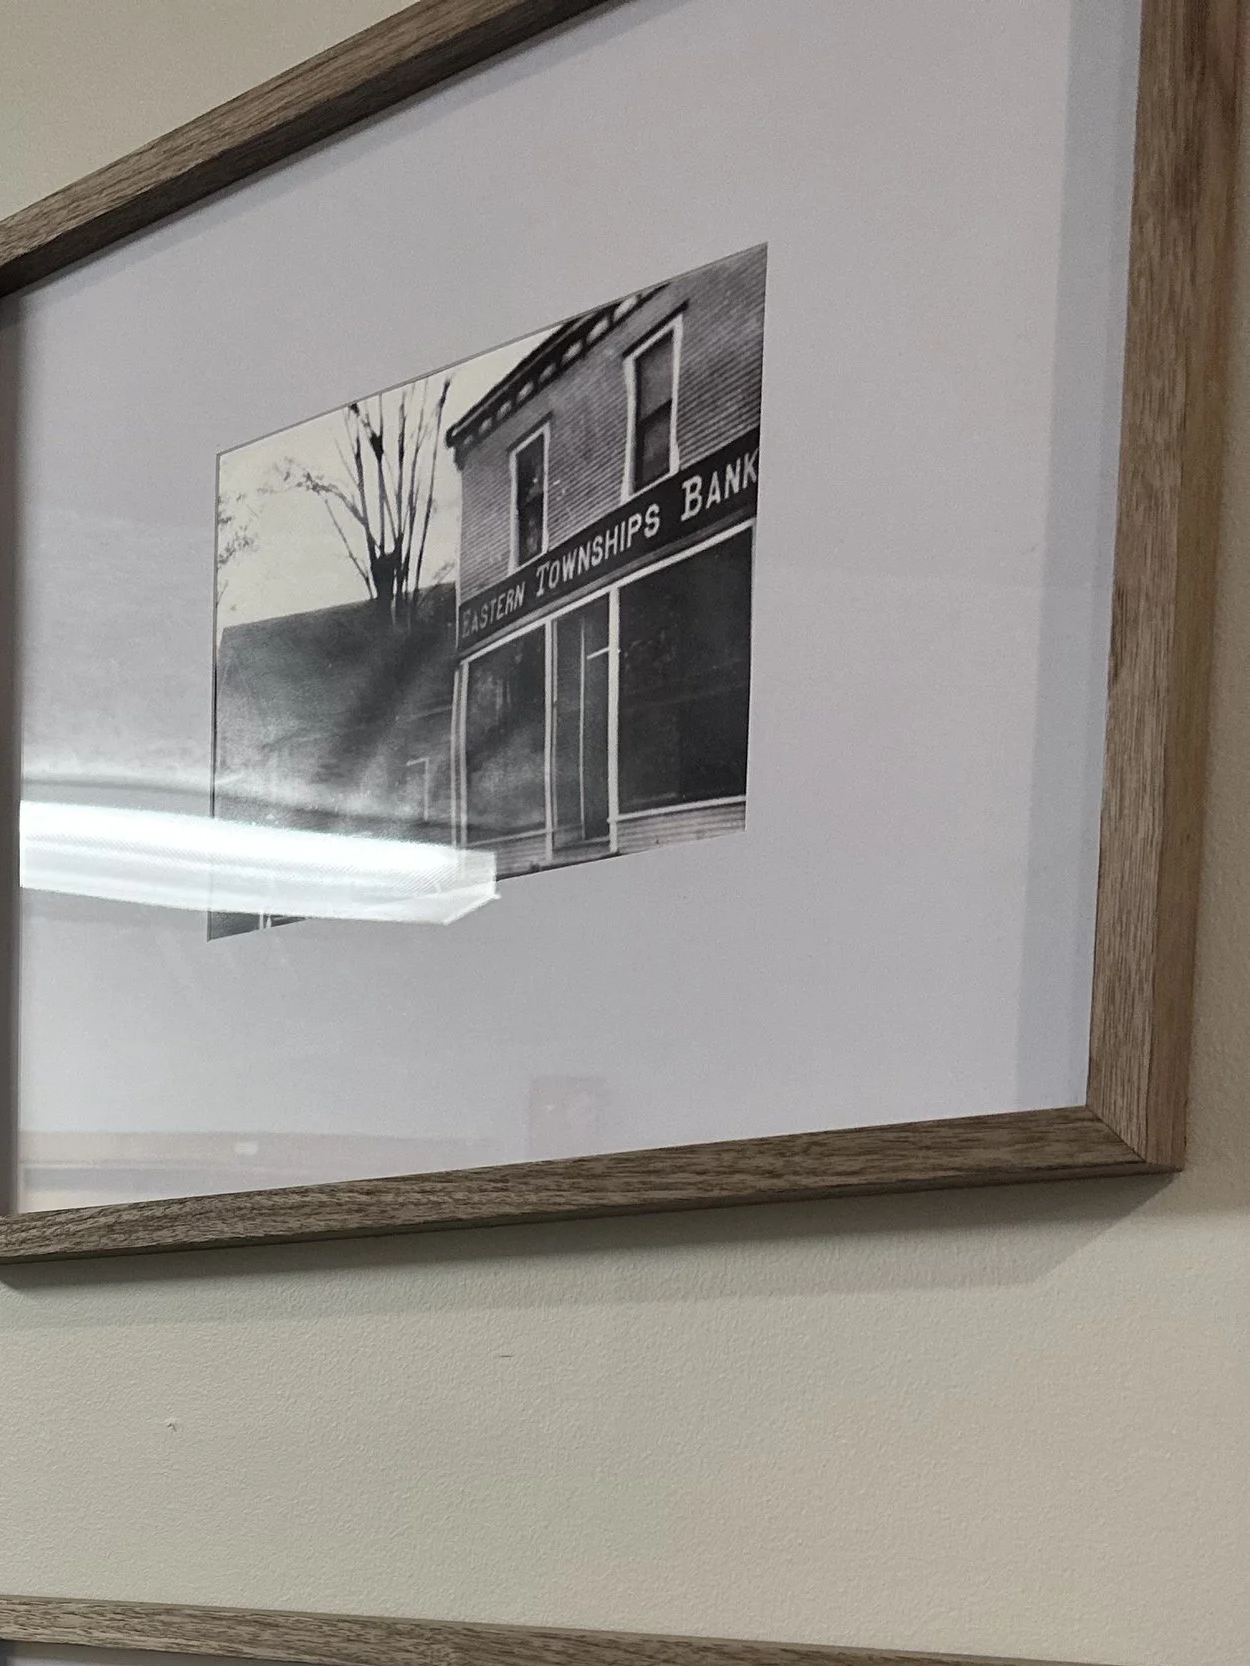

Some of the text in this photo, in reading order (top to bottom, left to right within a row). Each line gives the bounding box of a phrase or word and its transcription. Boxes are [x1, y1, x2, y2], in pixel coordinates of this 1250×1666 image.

[461, 448, 760, 639] EASTERN TOWNSHIPS BANK
